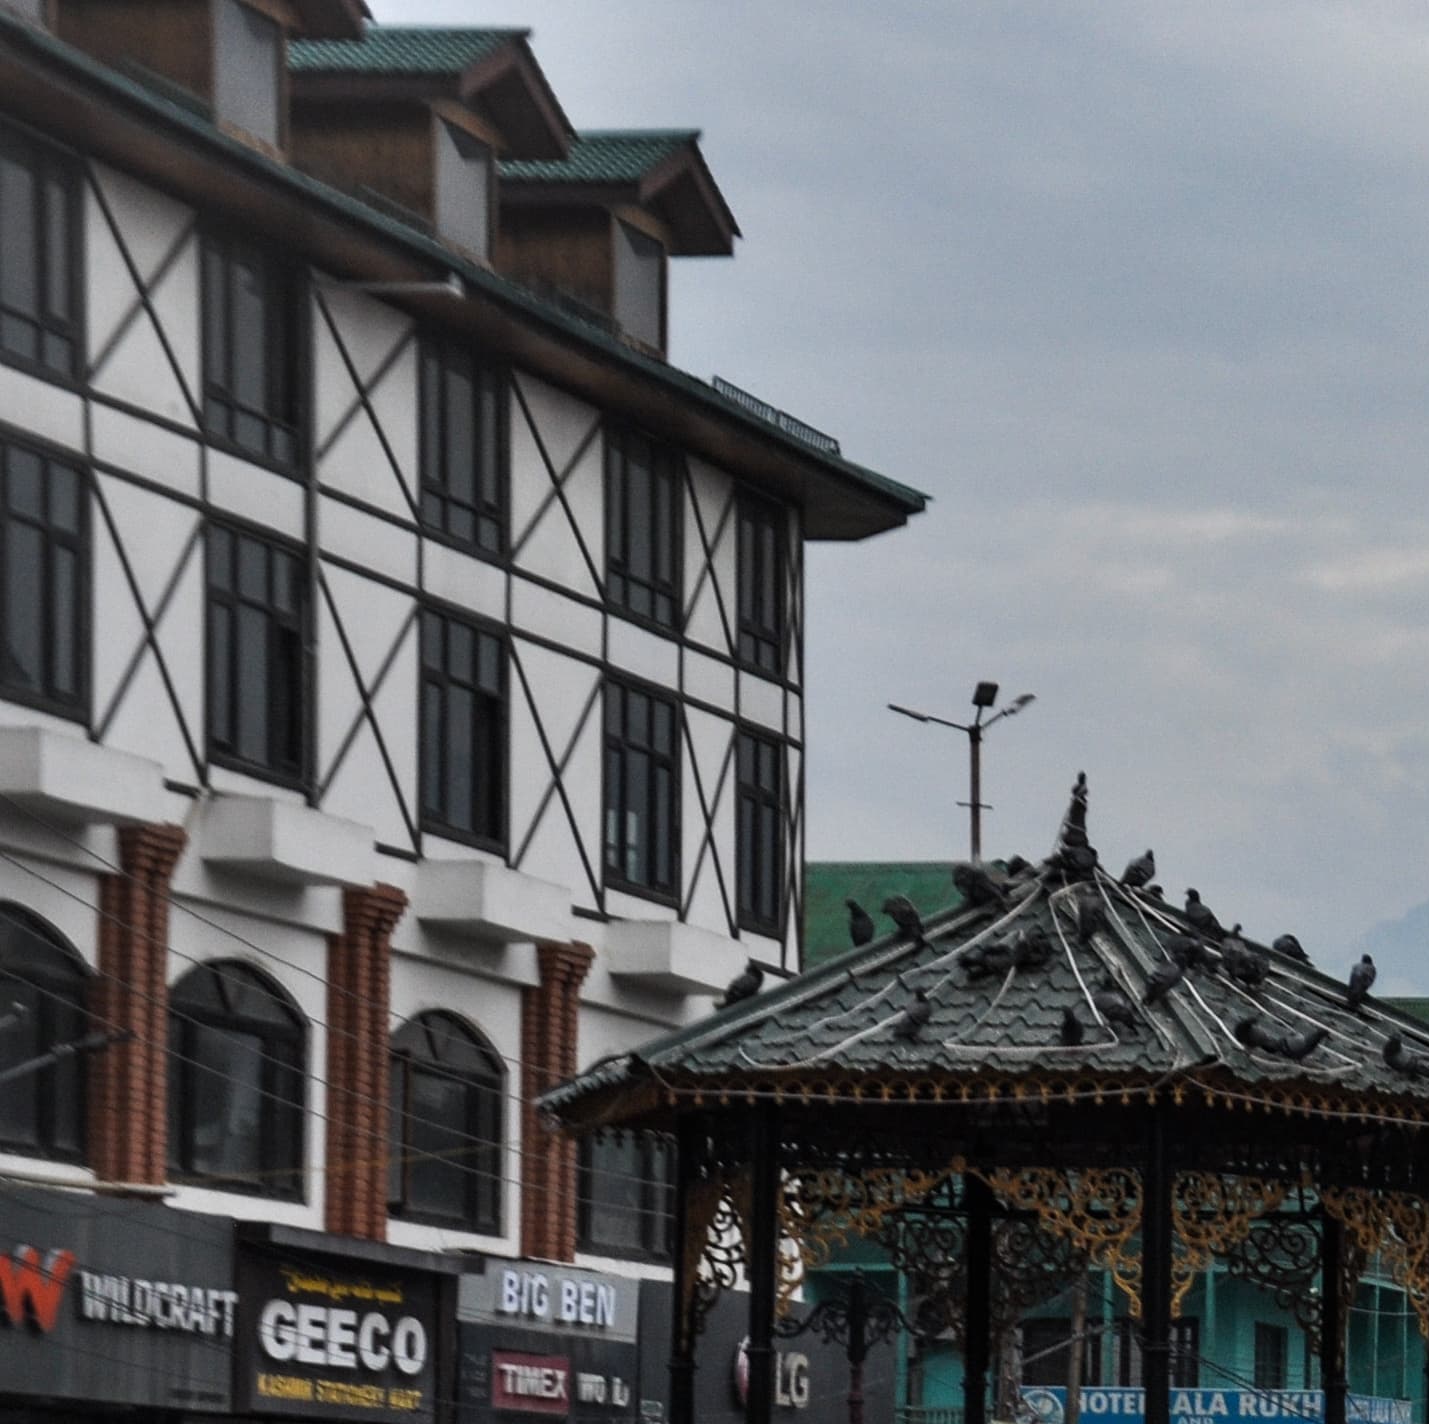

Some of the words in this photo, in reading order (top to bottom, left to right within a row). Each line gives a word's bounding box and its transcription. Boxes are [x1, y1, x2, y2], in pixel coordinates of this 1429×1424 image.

[81, 1270, 239, 1336] WILDCRAFT
[502, 1270, 549, 1317] BIG
[561, 1279, 615, 1327] BEN
[261, 1299, 427, 1374] GEECO
[499, 1363, 568, 1399] TIMEX
[576, 1371, 631, 1408] WOLD
[776, 1351, 810, 1409] LG
[1168, 1392, 1228, 1416] ALA
[1239, 1391, 1322, 1418] RUKH
